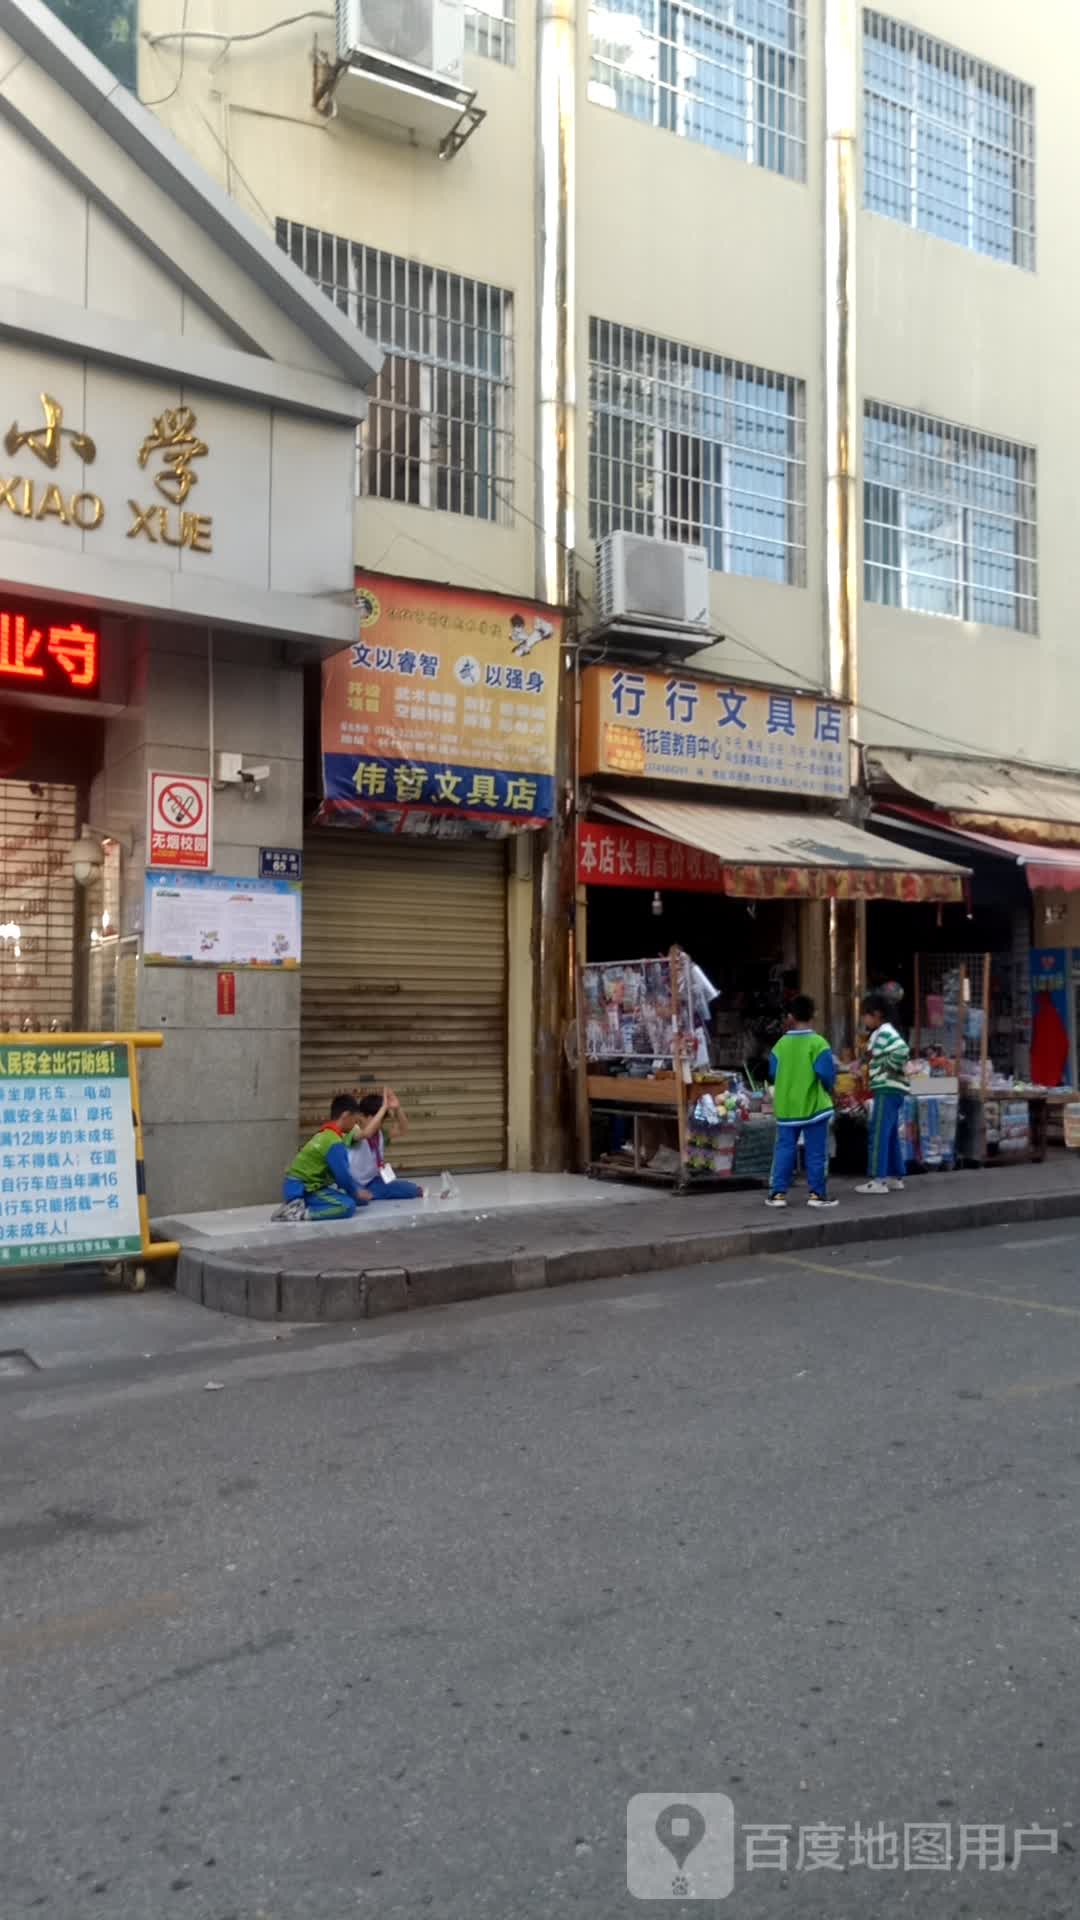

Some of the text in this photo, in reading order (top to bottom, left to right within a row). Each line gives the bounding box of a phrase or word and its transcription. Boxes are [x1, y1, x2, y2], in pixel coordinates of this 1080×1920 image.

[5, 392, 209, 504] 小学
[0, 475, 212, 554] XIAO XUE
[351, 643, 438, 677] 文以睿智
[612, 671, 841, 744] 行行文具店
[352, 762, 537, 811] 伟哲文具店
[152, 832, 207, 851] 无烟校园
[0, 1194, 119, 1216] 行车只能搭载一名
